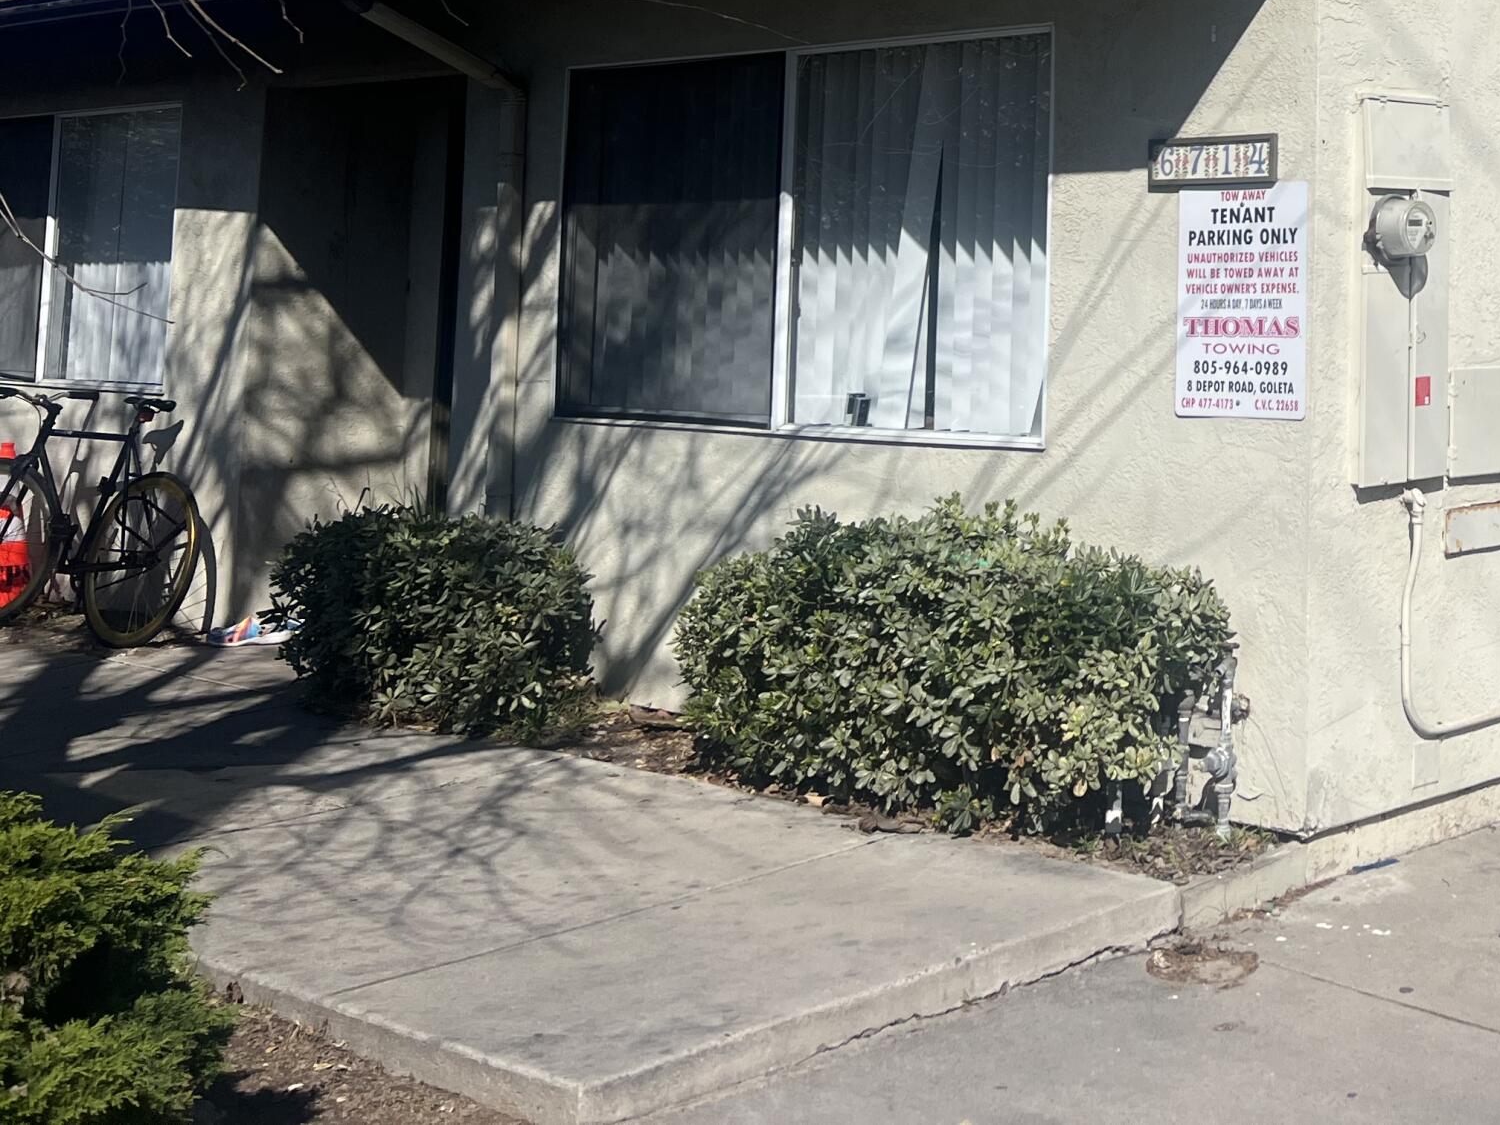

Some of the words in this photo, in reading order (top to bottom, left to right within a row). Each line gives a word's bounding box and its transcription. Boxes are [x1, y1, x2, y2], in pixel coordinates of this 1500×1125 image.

[1160, 143, 1266, 176] 6714
[1221, 191, 1239, 202] TOW
[1242, 190, 1266, 201] AWAY
[1211, 207, 1275, 224] TENANT
[1188, 229, 1253, 246] PARKING
[1260, 227, 1298, 245] ONLY
[1187, 252, 1255, 264] UNAUTHORIZED
[1258, 251, 1298, 262] VEHICLES
[1186, 268, 1206, 279] WILL
[1210, 268, 1221, 279] BE
[1224, 267, 1254, 278] TOWED
[1257, 267, 1285, 278] AWAY
[1288, 267, 1299, 277] AT
[1186, 283, 1218, 294] VEHICLE
[1221, 283, 1257, 294] OWNER'S
[1261, 282, 1299, 294] EXPENSE.
[1209, 299, 1226, 309] HOURS
[1249, 299, 1262, 309] DAYS
[1268, 299, 1283, 309] WEEK
[1183, 316, 1301, 338] THOMAS
[1202, 343, 1280, 355] TOWING
[1193, 360, 1288, 375] 805-964-0989
[1186, 380, 1193, 392] 8
[1196, 380, 1225, 393] DEPOT
[1228, 381, 1256, 395] ROAD,
[1259, 382, 1294, 394] GOLETA
[1181, 397, 1196, 408] CHP
[1198, 398, 1234, 410] 477-4173
[1276, 400, 1299, 412] 22658
